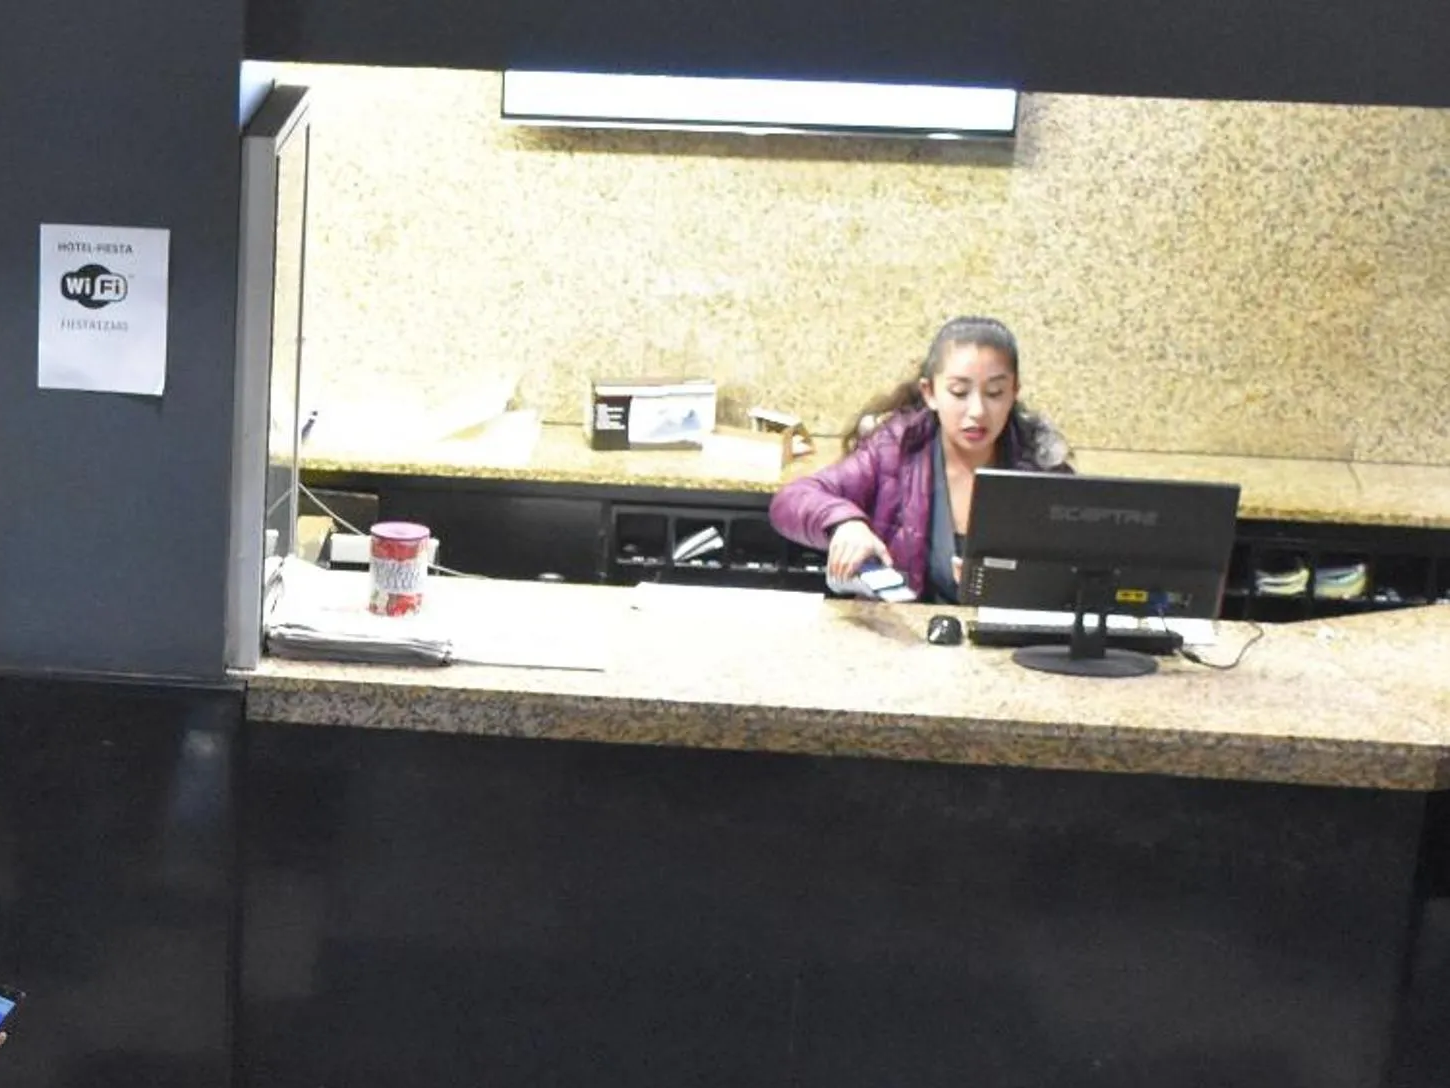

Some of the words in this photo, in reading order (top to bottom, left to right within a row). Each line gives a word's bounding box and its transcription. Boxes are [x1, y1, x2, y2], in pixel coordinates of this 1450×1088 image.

[57, 241, 93, 252] HOTEL
[65, 276, 121, 296] WiFi
[1050, 505, 1159, 526] SCEPTRE
